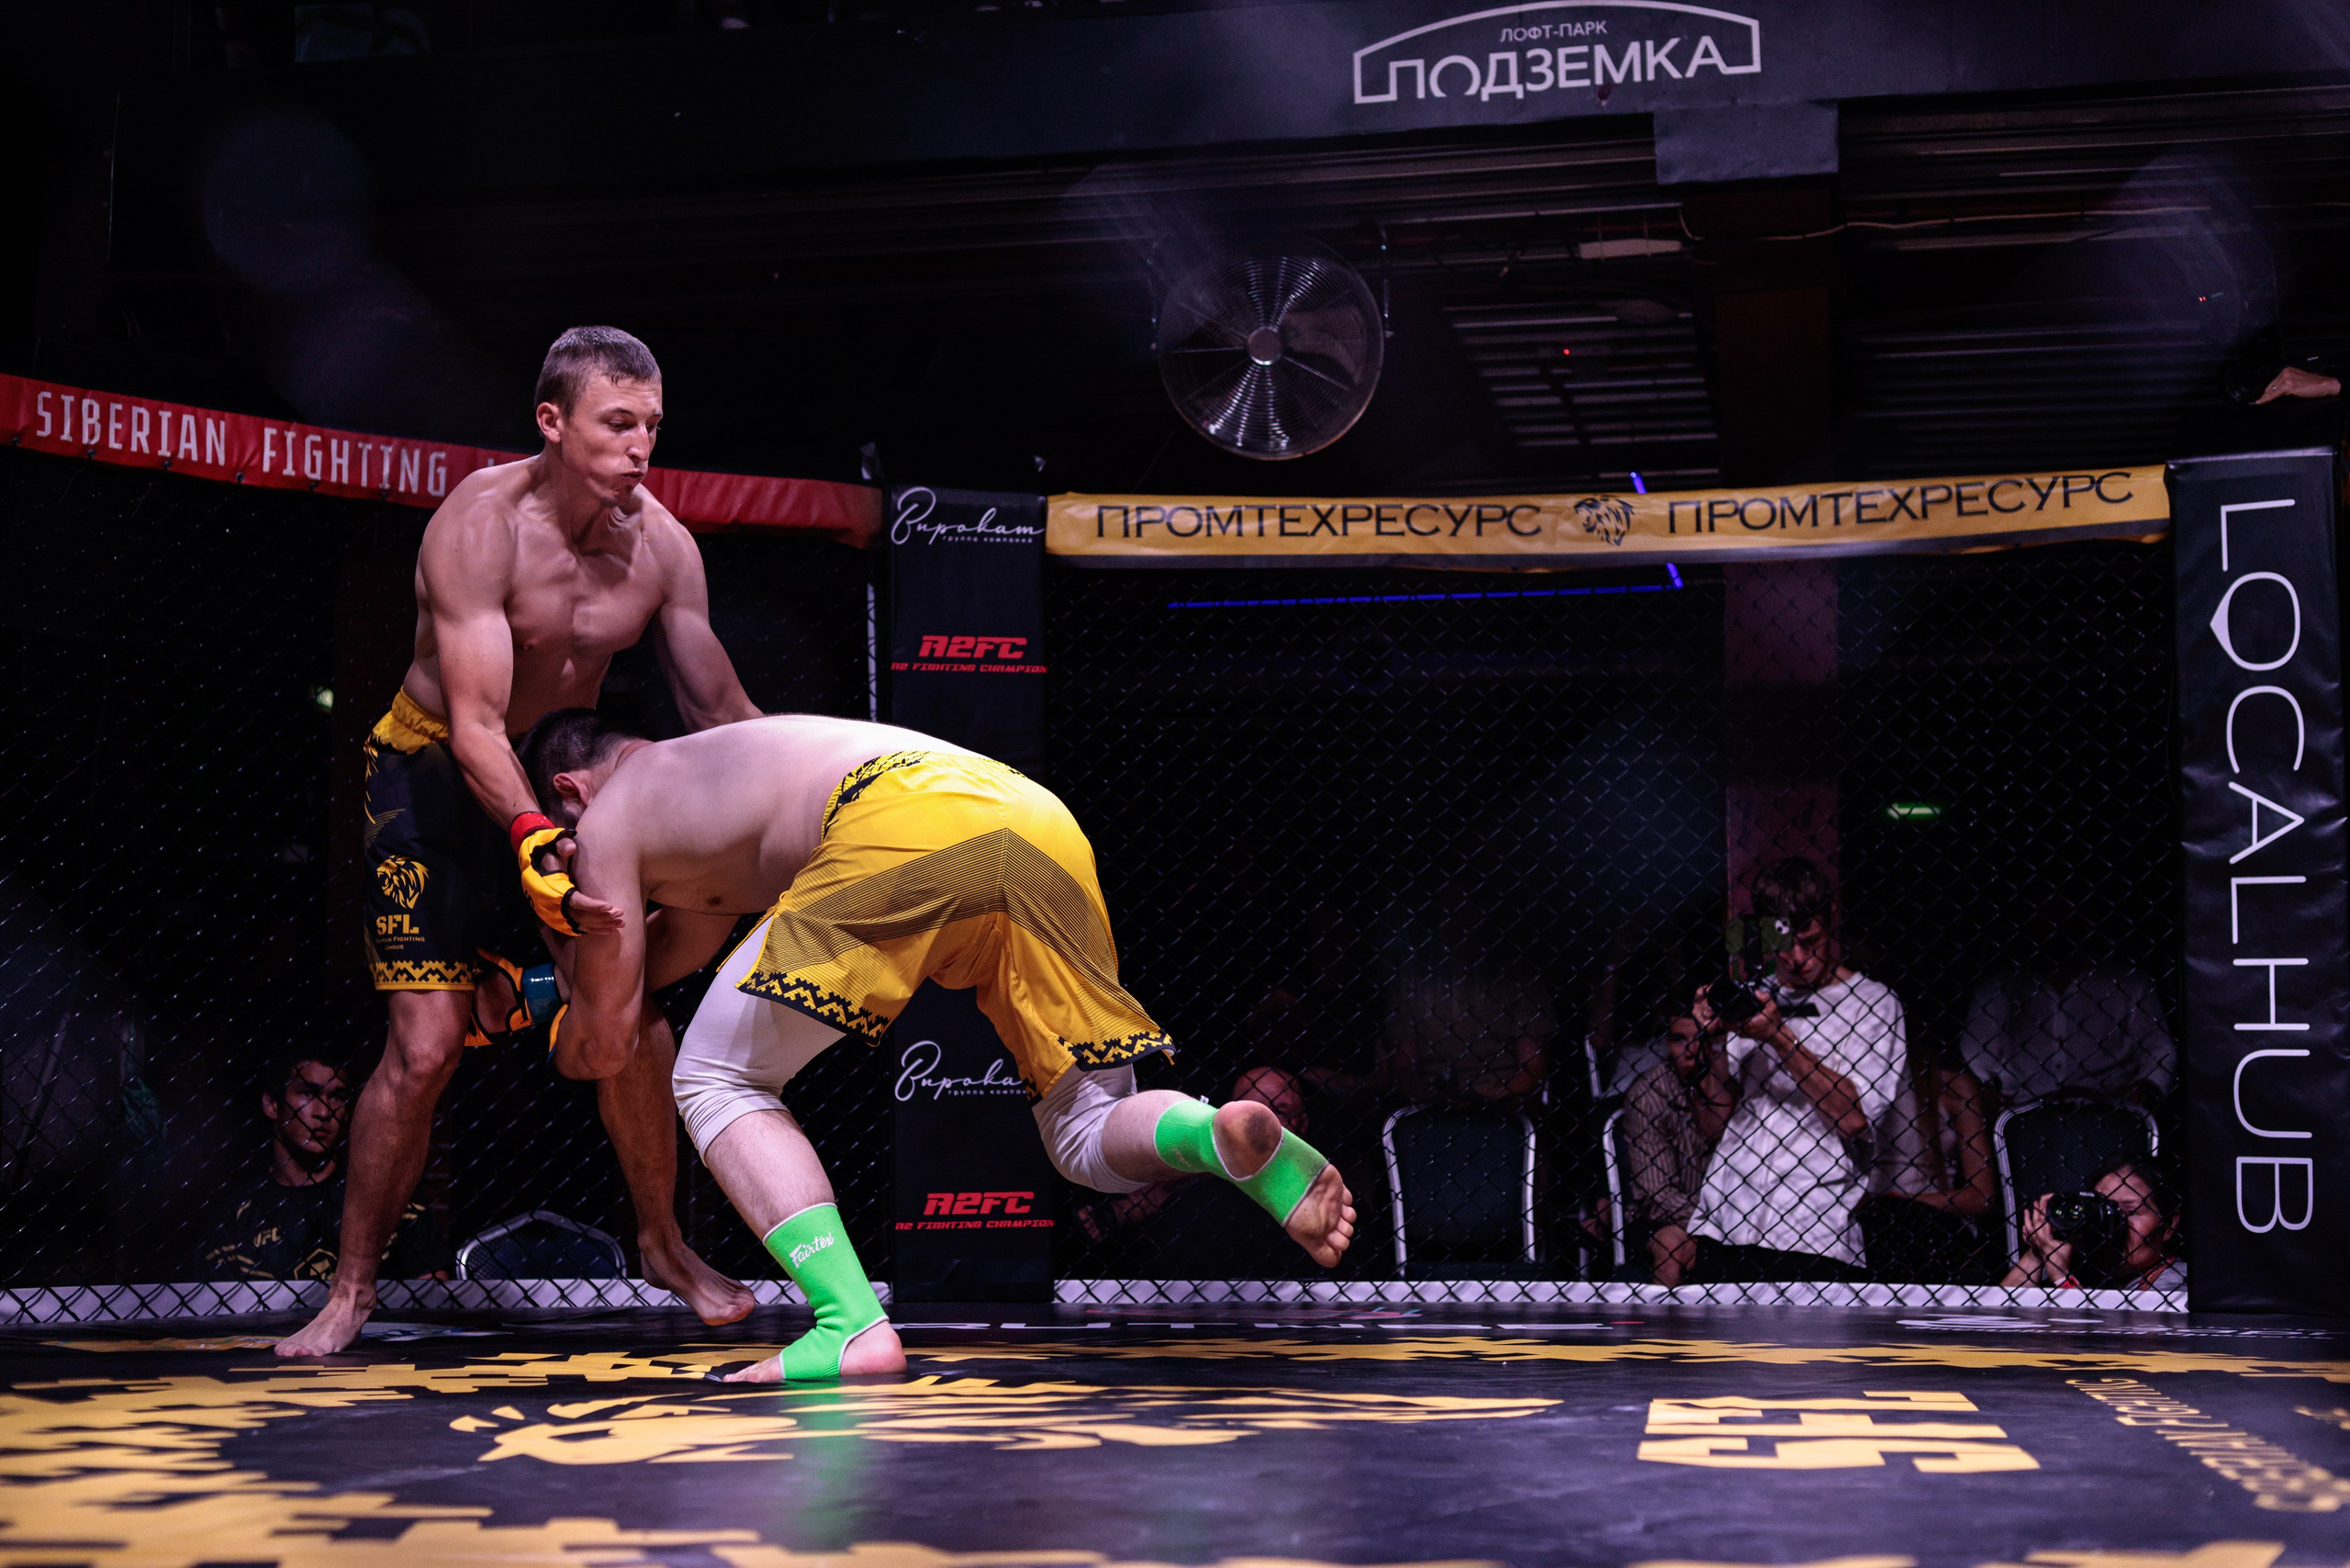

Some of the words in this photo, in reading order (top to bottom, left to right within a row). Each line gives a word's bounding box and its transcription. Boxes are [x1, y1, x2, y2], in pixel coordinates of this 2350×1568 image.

[1499, 20, 1607, 42] ЛОФТ-ПАРК
[1388, 35, 1728, 102] ПОДЗЕМКА
[37, 391, 226, 466] SIBERIAN
[263, 427, 447, 498] FIGHTING
[1097, 504, 1541, 538] ПРОМТЕХРЕСУРС
[1668, 472, 2134, 534] ПРОМТЕХРЕСУРС
[2210, 498, 2314, 1234] LOCALHUB
[375, 913, 420, 935] SFL
[789, 1232, 834, 1269] Fairtex
